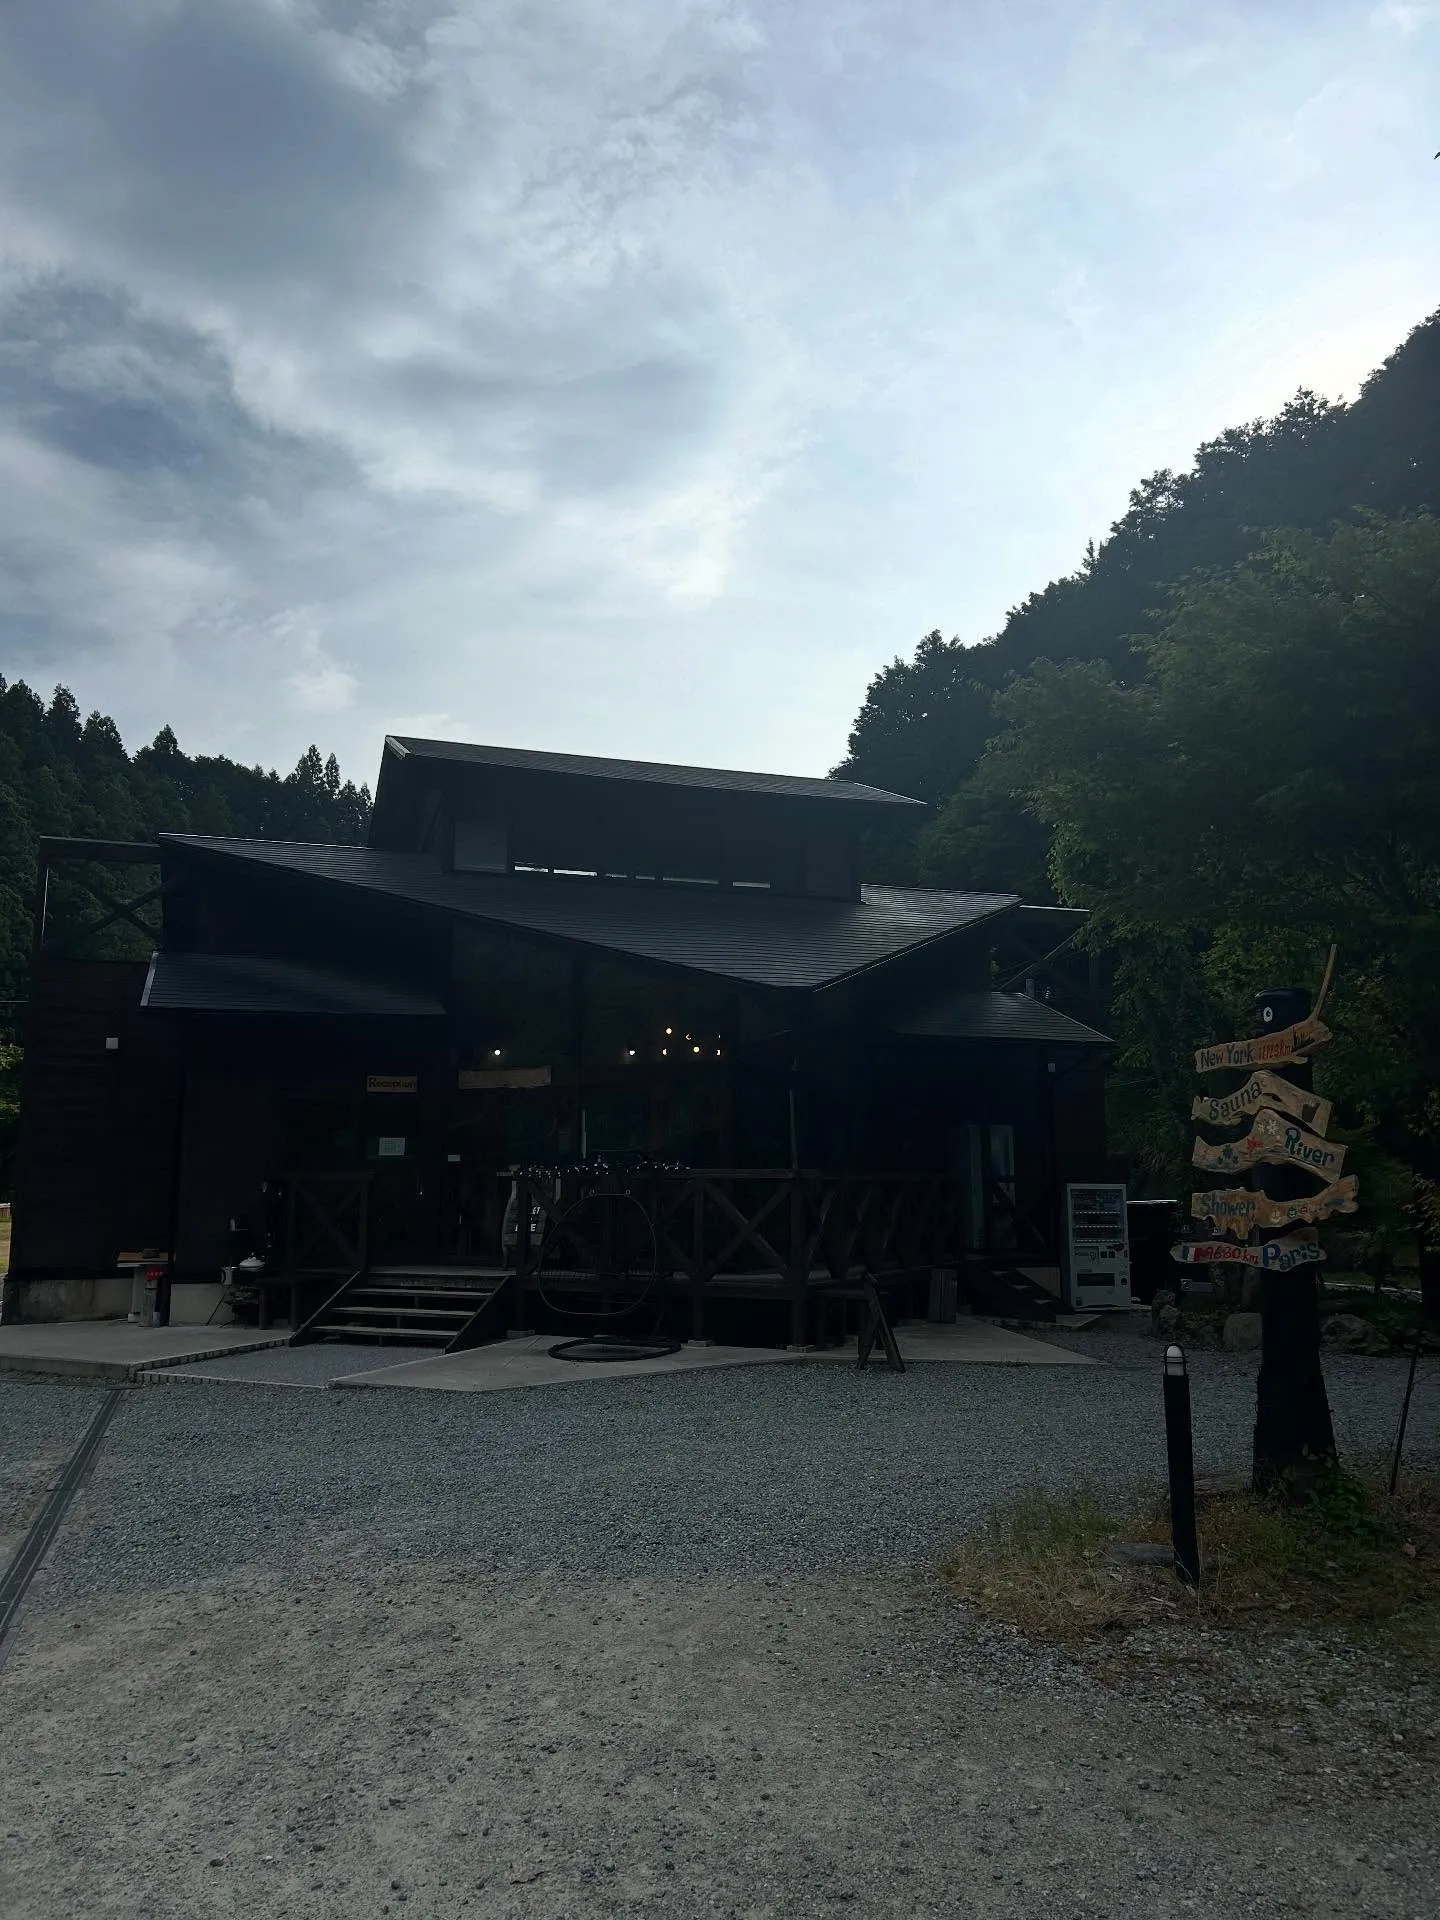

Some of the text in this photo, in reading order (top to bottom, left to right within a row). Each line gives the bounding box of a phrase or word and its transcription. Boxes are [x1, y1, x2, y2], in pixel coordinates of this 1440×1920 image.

[1200, 1049, 1224, 1068] New
[1226, 1042, 1255, 1063] York
[368, 1077, 416, 1091] Reception
[1210, 1081, 1262, 1119] Sauna
[1285, 1127, 1334, 1165] River
[1202, 1194, 1256, 1217] Shower
[1262, 1243, 1320, 1270] Paris
